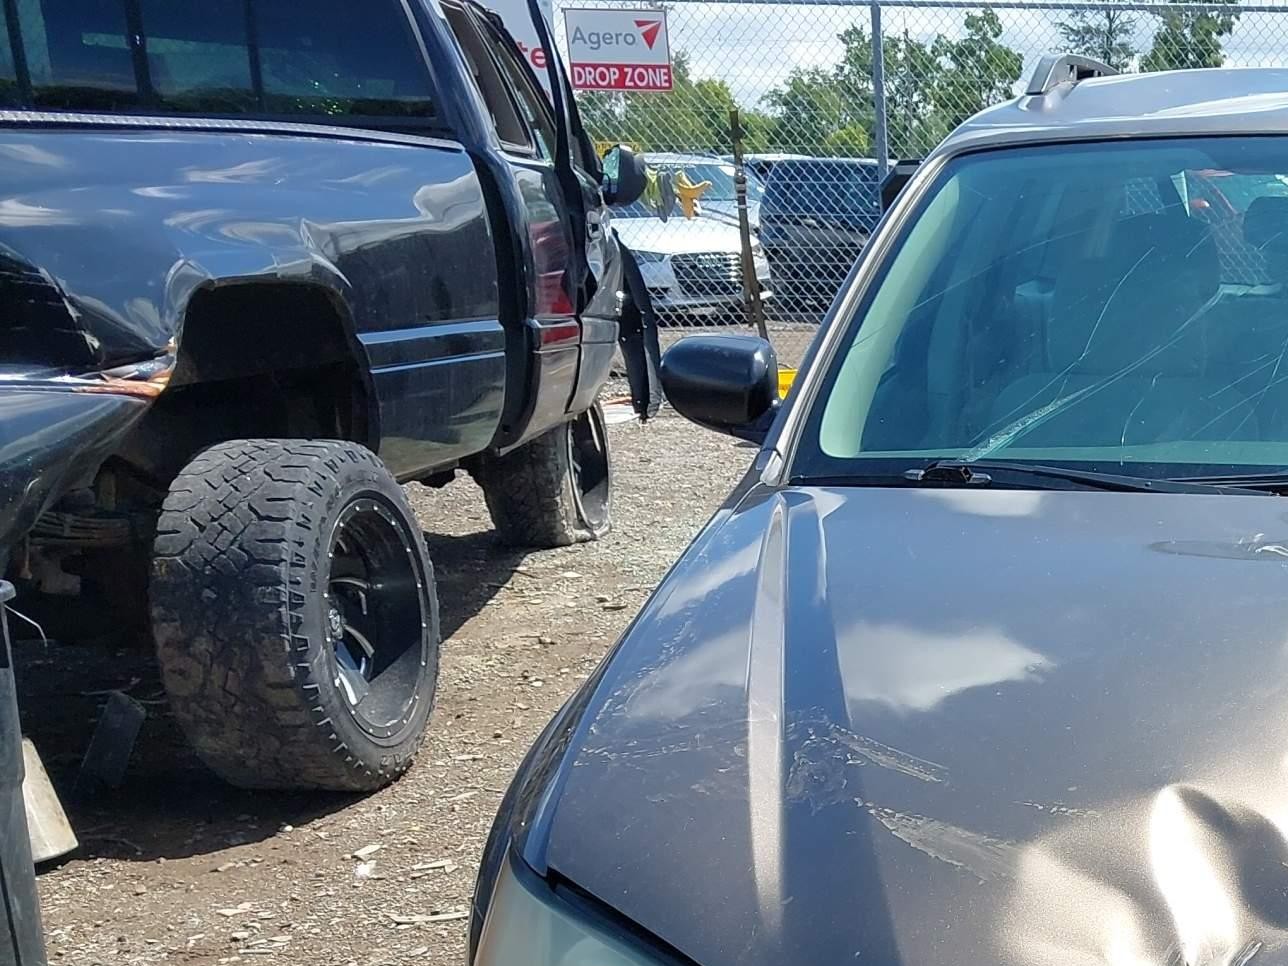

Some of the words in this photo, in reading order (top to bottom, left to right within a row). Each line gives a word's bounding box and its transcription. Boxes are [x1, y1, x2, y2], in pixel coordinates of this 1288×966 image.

[571, 26, 636, 50] Agero
[573, 66, 620, 86] DROP
[624, 67, 670, 87] ZONE
